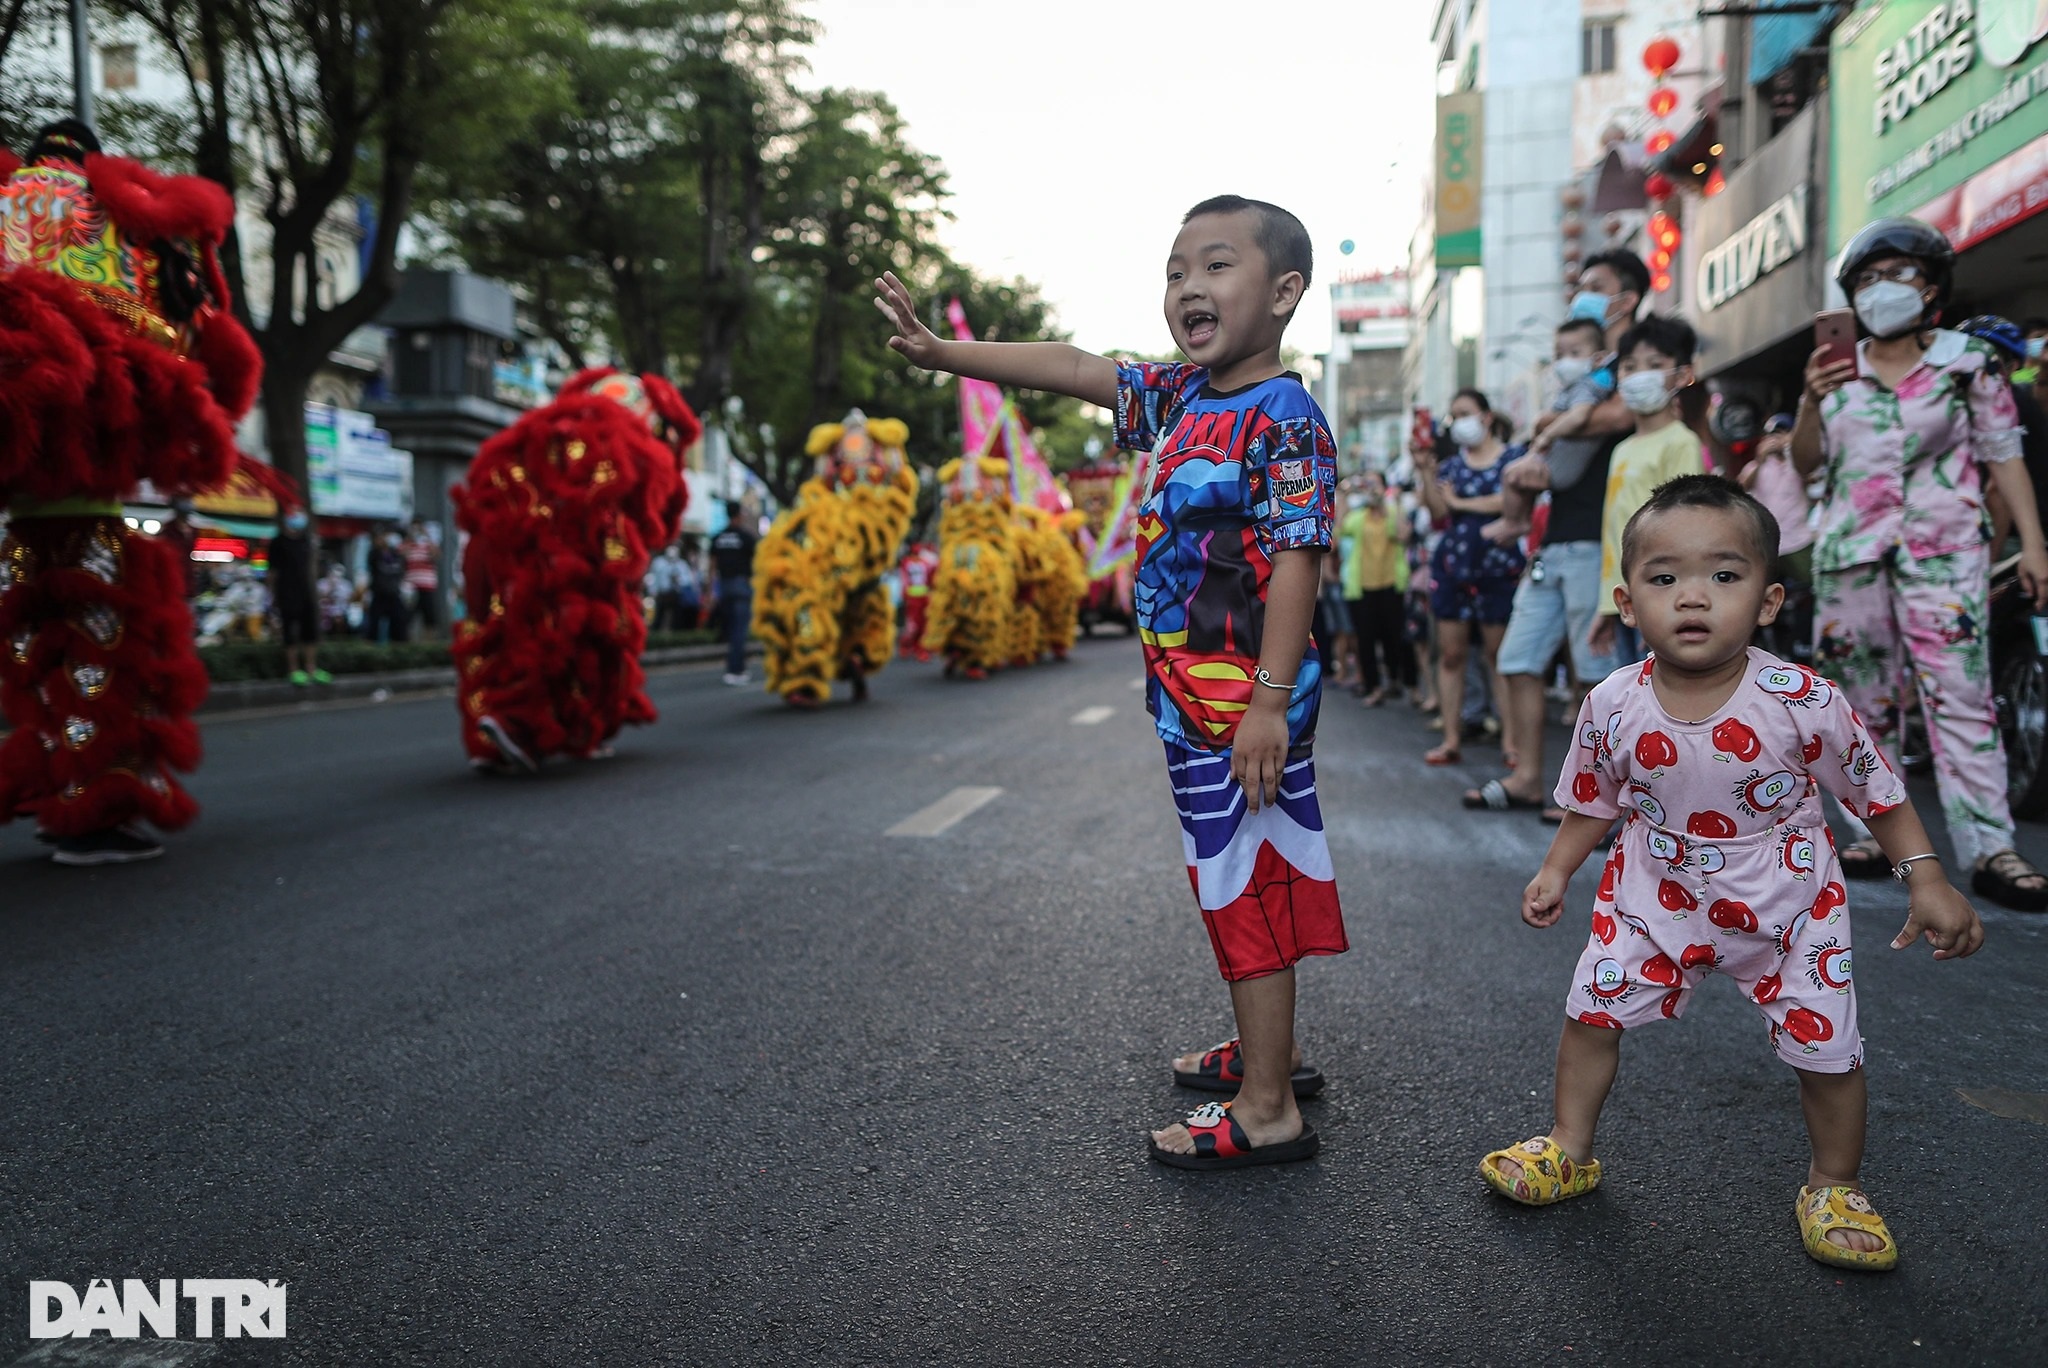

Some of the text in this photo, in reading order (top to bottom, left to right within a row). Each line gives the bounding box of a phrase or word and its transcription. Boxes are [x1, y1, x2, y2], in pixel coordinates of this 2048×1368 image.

[1873, 0, 1974, 89] SATRA
[1872, 28, 1975, 136] FOODS
[1272, 475, 1314, 498] SUPERMAN
[1273, 518, 1317, 543] SUPERMAN
